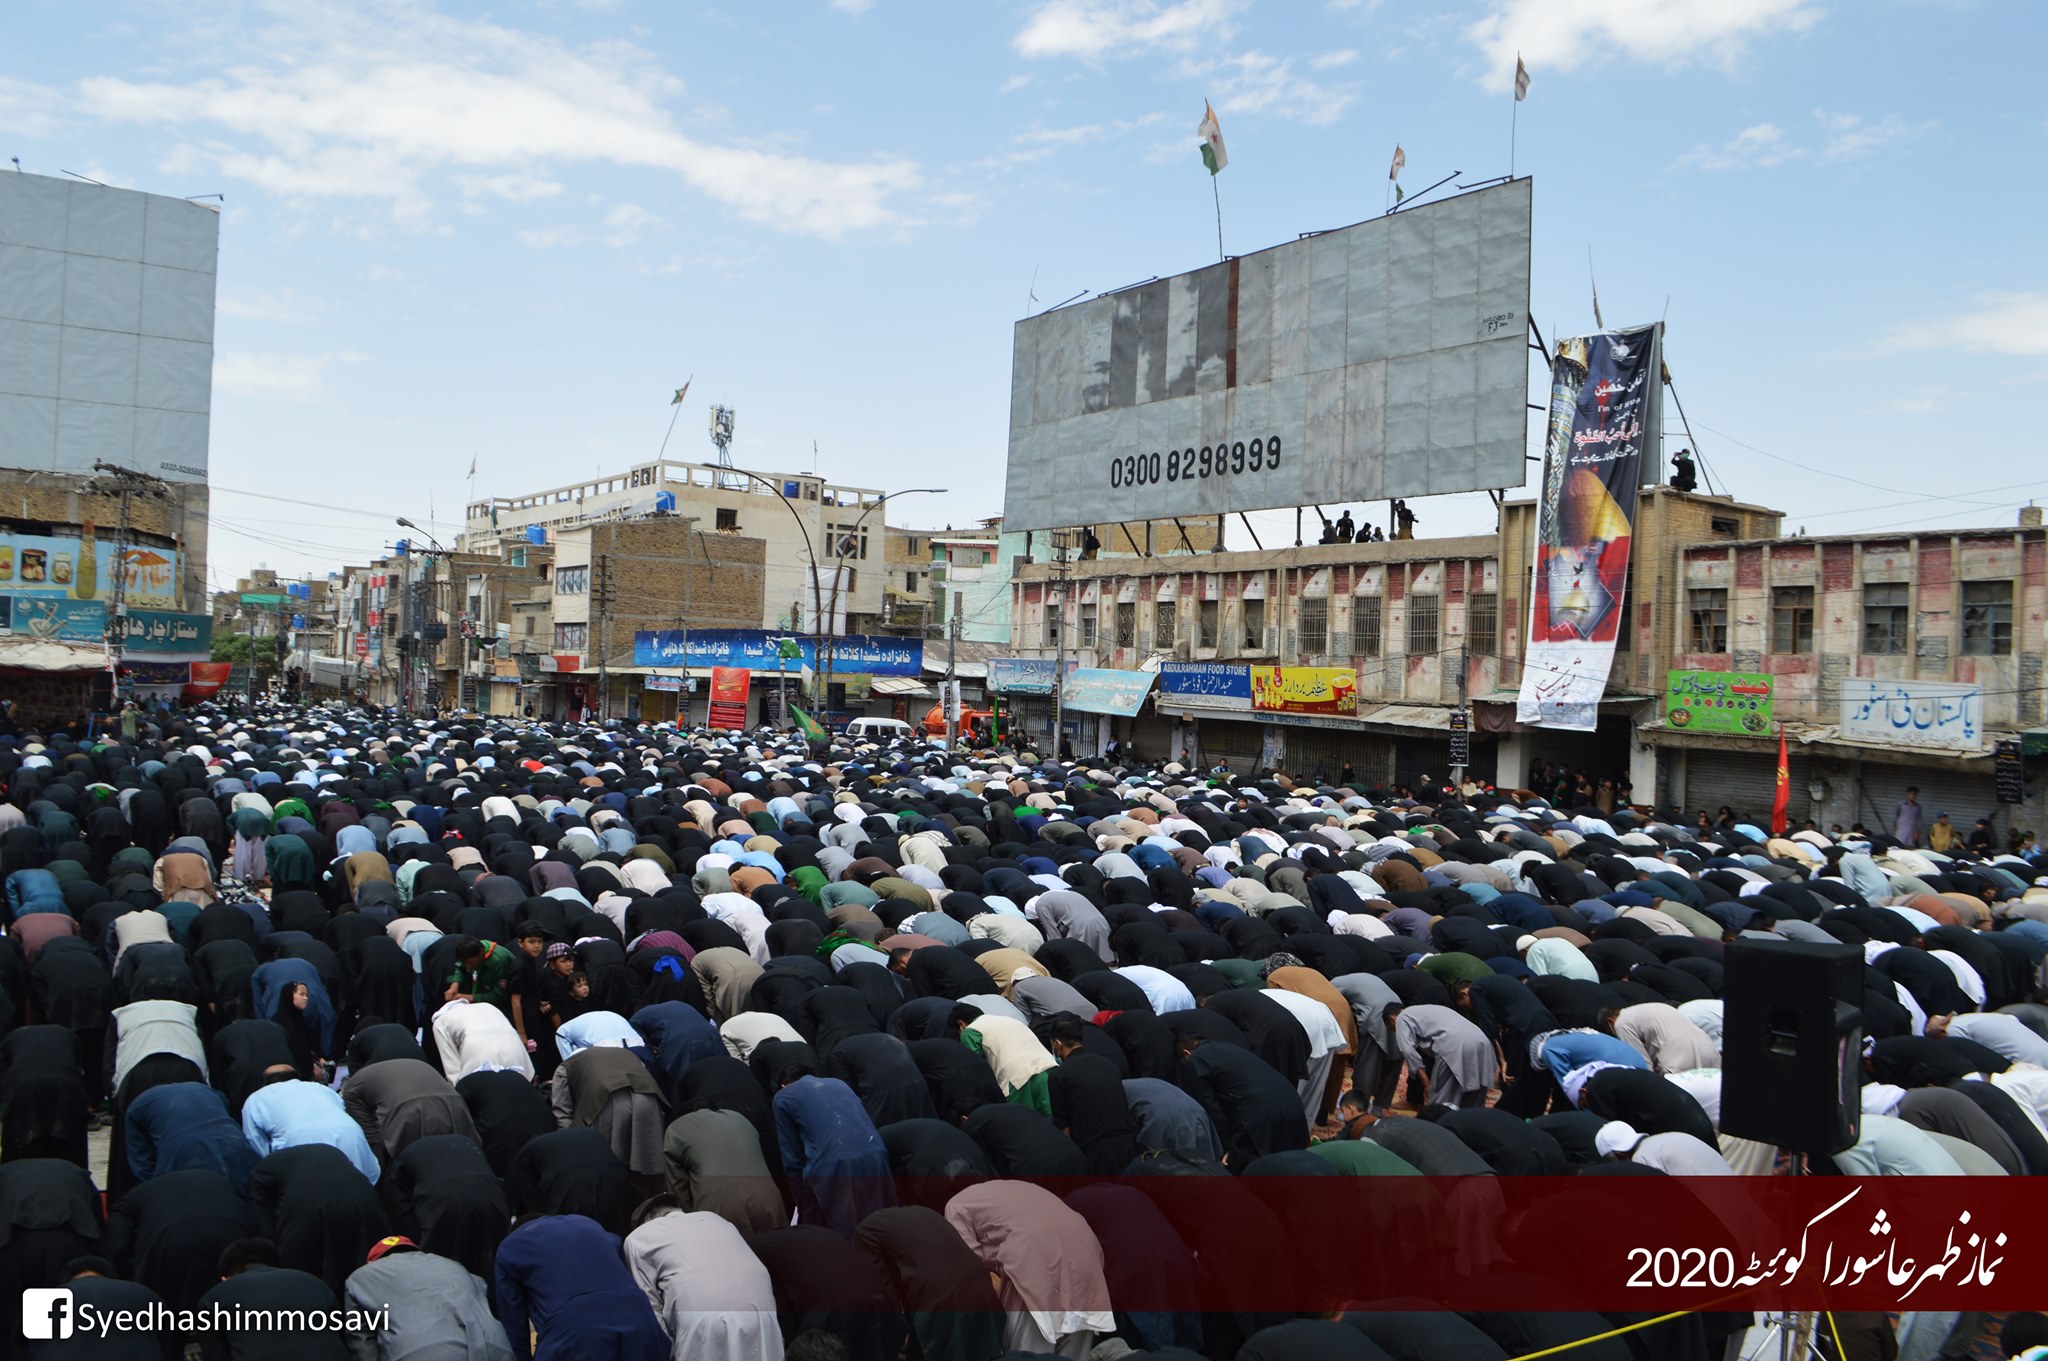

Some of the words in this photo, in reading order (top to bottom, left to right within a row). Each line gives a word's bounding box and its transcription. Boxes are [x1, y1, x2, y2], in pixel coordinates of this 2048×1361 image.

[1111, 452, 1161, 488] 0300
[1167, 435, 1281, 482] 8298999
[1163, 663, 1207, 674] ABDULRAHMAN
[1208, 664, 1225, 675] FOOD
[1225, 665, 1247, 676] STORE
[1851, 682, 1889, 721] اسٹور
[1891, 687, 1913, 728] ٹی
[1913, 689, 1978, 739] پاکستان
